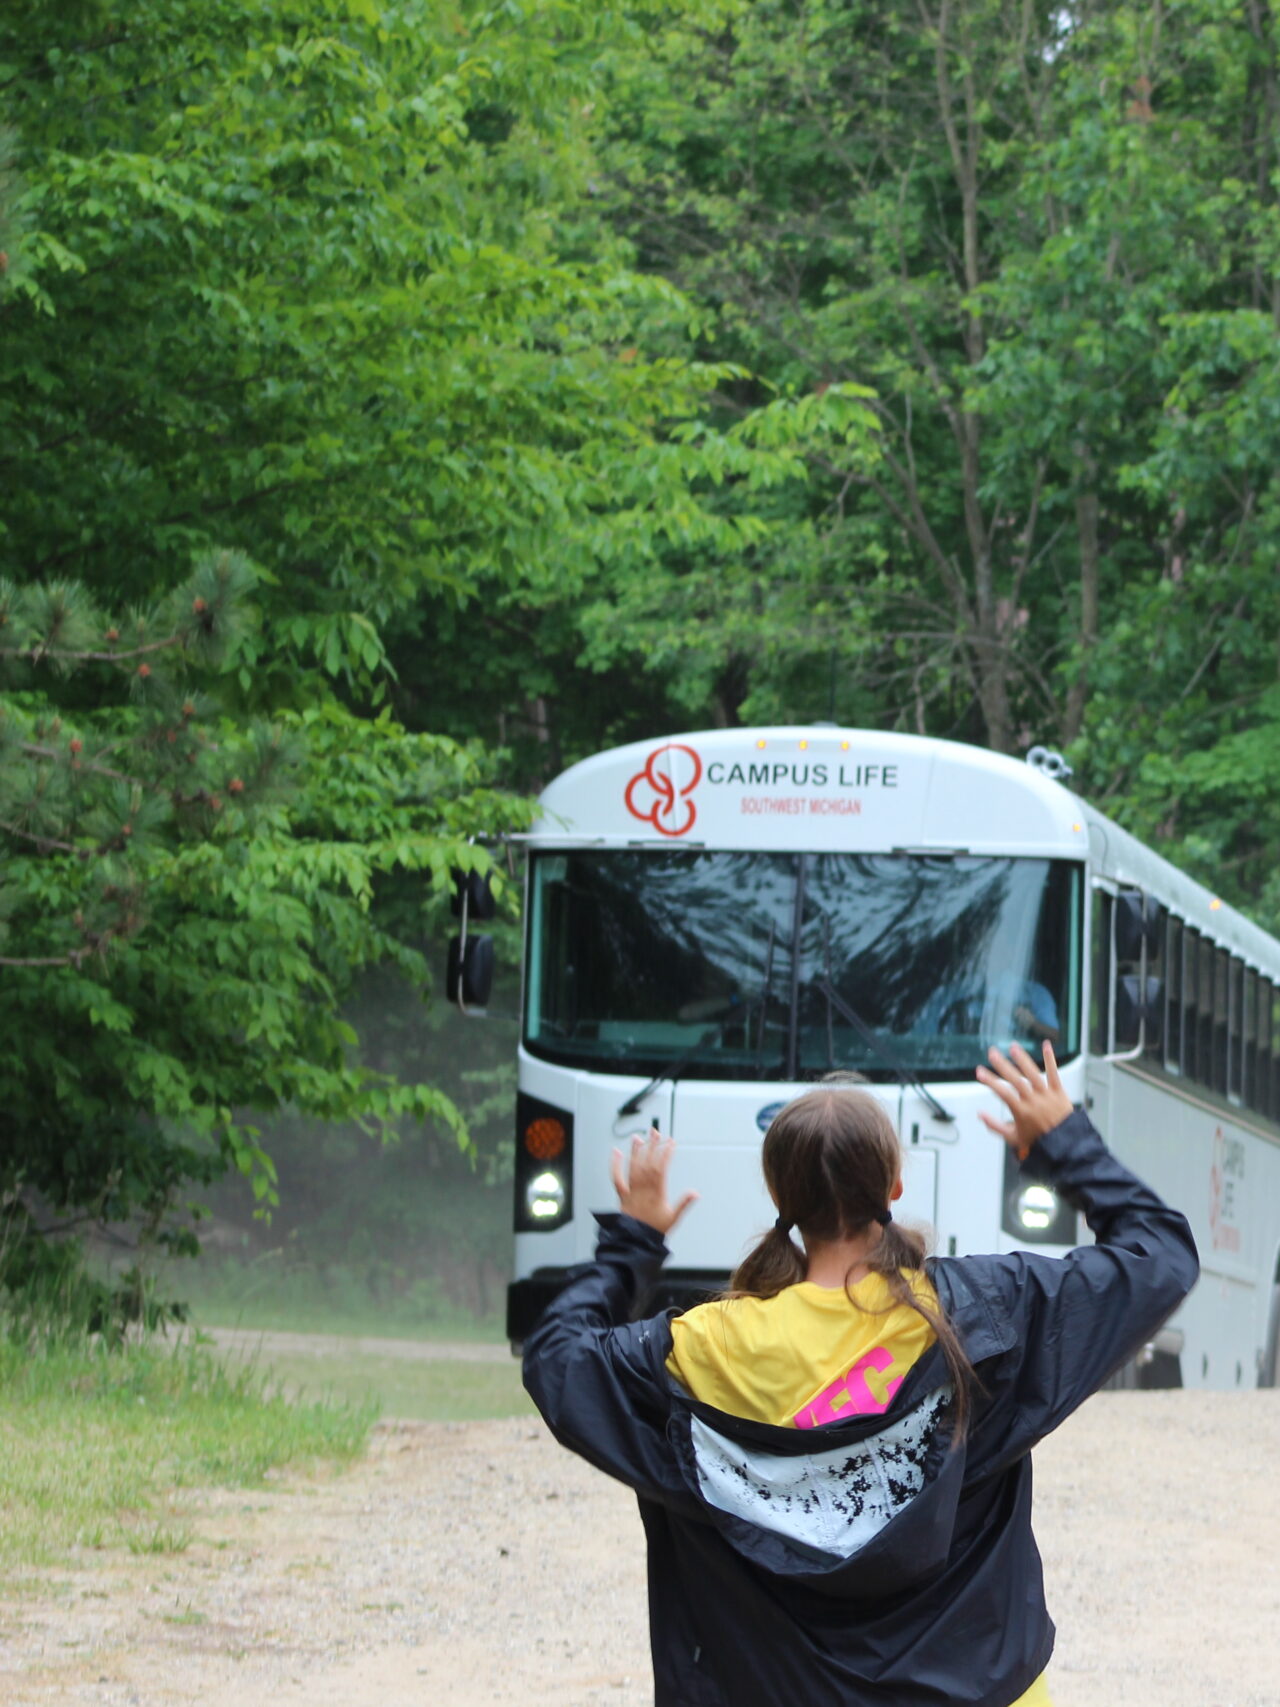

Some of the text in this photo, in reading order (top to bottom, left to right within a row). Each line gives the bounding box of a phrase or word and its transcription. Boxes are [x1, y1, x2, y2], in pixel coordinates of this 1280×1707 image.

[707, 762, 899, 788] CAMPUS LIFE
[740, 797, 862, 816] SOUTHWEST MICHIGAN
